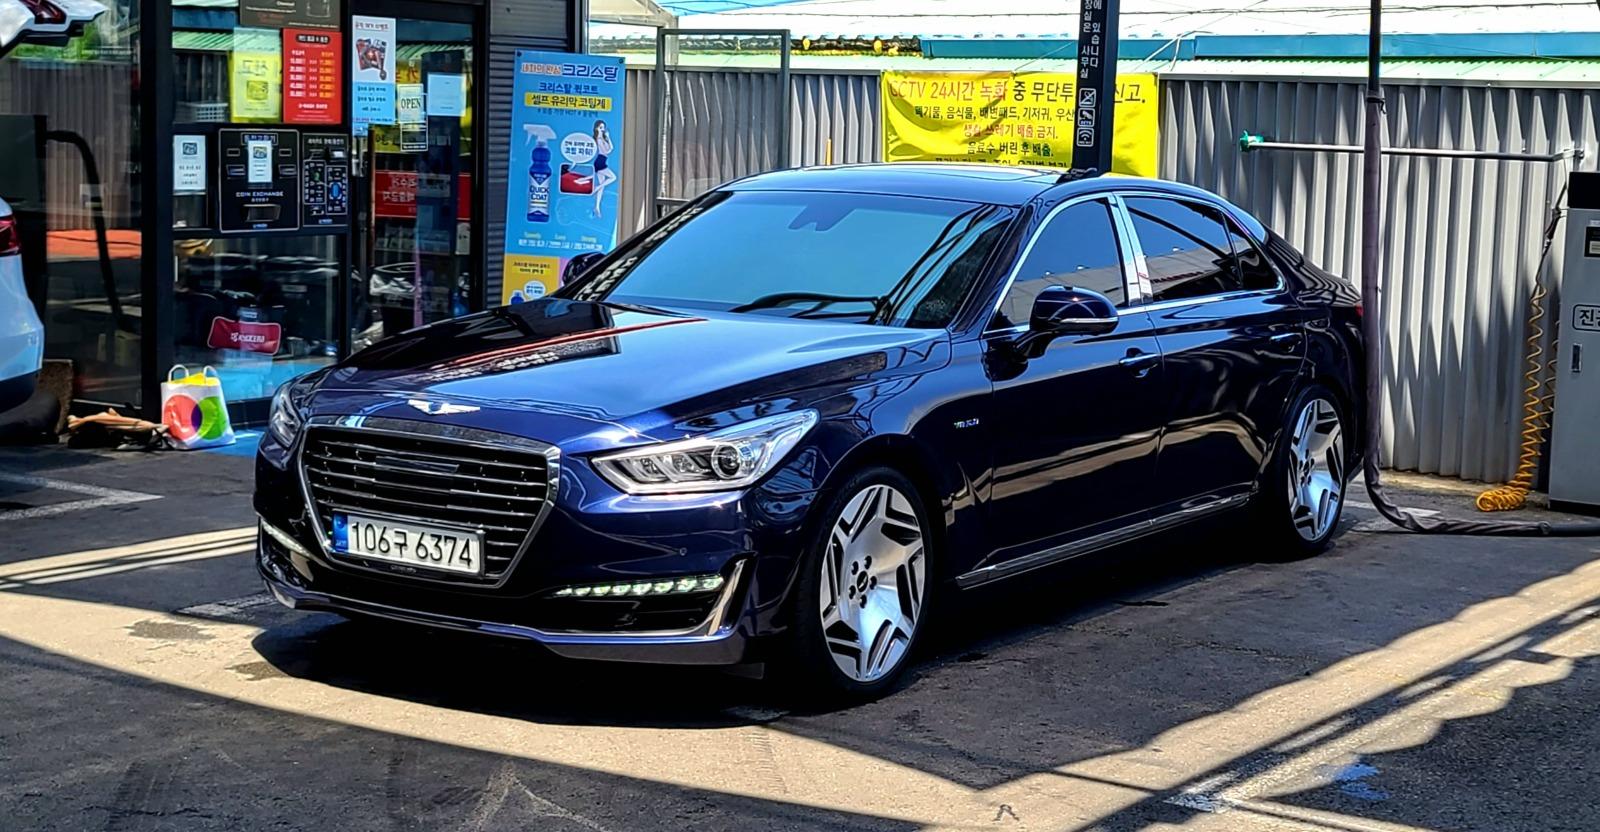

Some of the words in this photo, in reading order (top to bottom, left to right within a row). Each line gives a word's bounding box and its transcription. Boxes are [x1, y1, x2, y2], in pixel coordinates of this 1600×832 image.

[1090, 22, 1101, 68] 있습니다
[1080, 45, 1090, 79] 사무실
[562, 64, 618, 82] 크리스탈
[539, 82, 572, 94] 크리스탈
[890, 81, 926, 100] CCTV
[931, 81, 975, 102] 24시간
[980, 81, 1007, 102] 녹화
[1012, 81, 1026, 101] 중
[1030, 82, 1073, 103] 무단투
[401, 98, 421, 109] OPEN
[532, 94, 550, 105] 셀프
[552, 96, 577, 107] 유리막
[947, 106, 976, 121] 음식물,
[980, 107, 1020, 121] 배변패드,
[1022, 107, 1053, 121] 기저귀,
[985, 124, 1014, 138] 쓰레기
[1017, 125, 1034, 138] 배출
[1037, 125, 1058, 139] 금지.
[968, 142, 996, 156] 음료수
[999, 142, 1018, 155] 버린
[1021, 142, 1030, 155] 후
[1032, 143, 1054, 157] 배출.
[530, 185, 549, 193] QUICK
[352, 521, 408, 558] 106구
[415, 532, 472, 568] 6374
